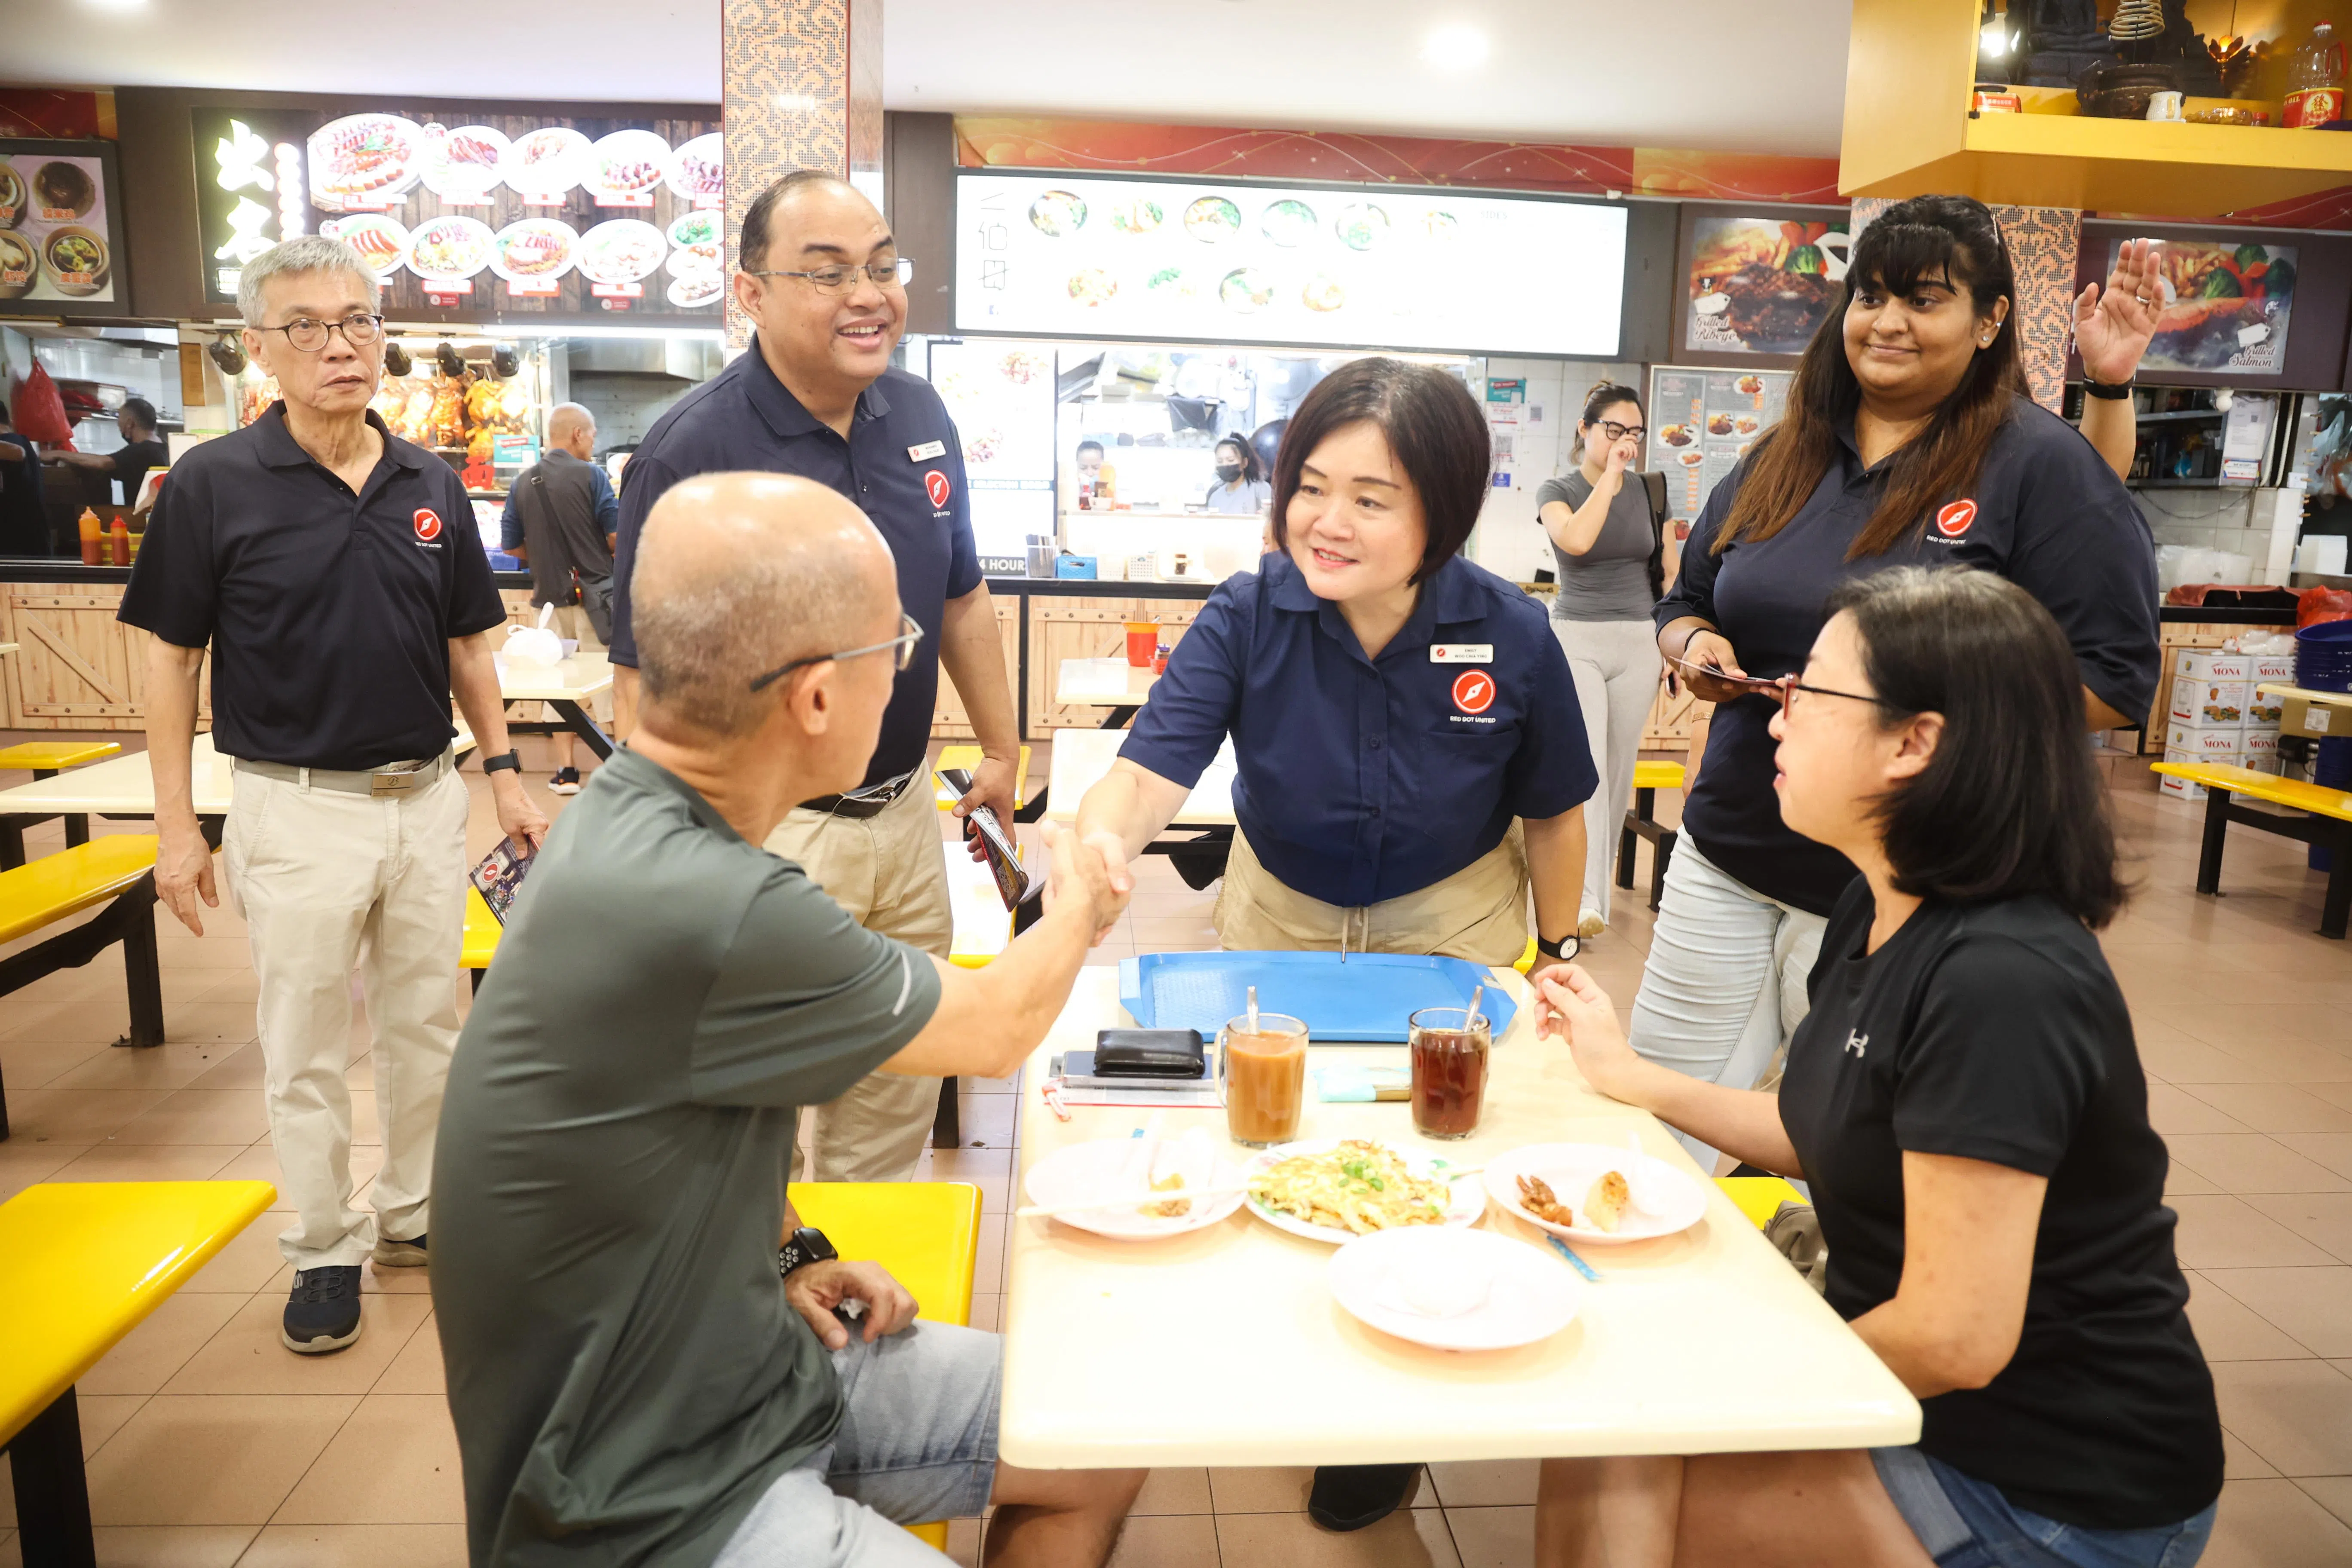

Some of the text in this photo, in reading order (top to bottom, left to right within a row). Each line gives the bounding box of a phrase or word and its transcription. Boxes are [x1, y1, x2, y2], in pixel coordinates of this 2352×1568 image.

[2243, 343, 2275, 357] Grilled
[2229, 352, 2273, 368] Salmon
[989, 558, 1026, 572] HOUR
[2212, 668, 2241, 676] MONA
[2259, 668, 2287, 677] MONA
[2204, 740, 2231, 749] MONA
[2250, 740, 2277, 749] MONA
